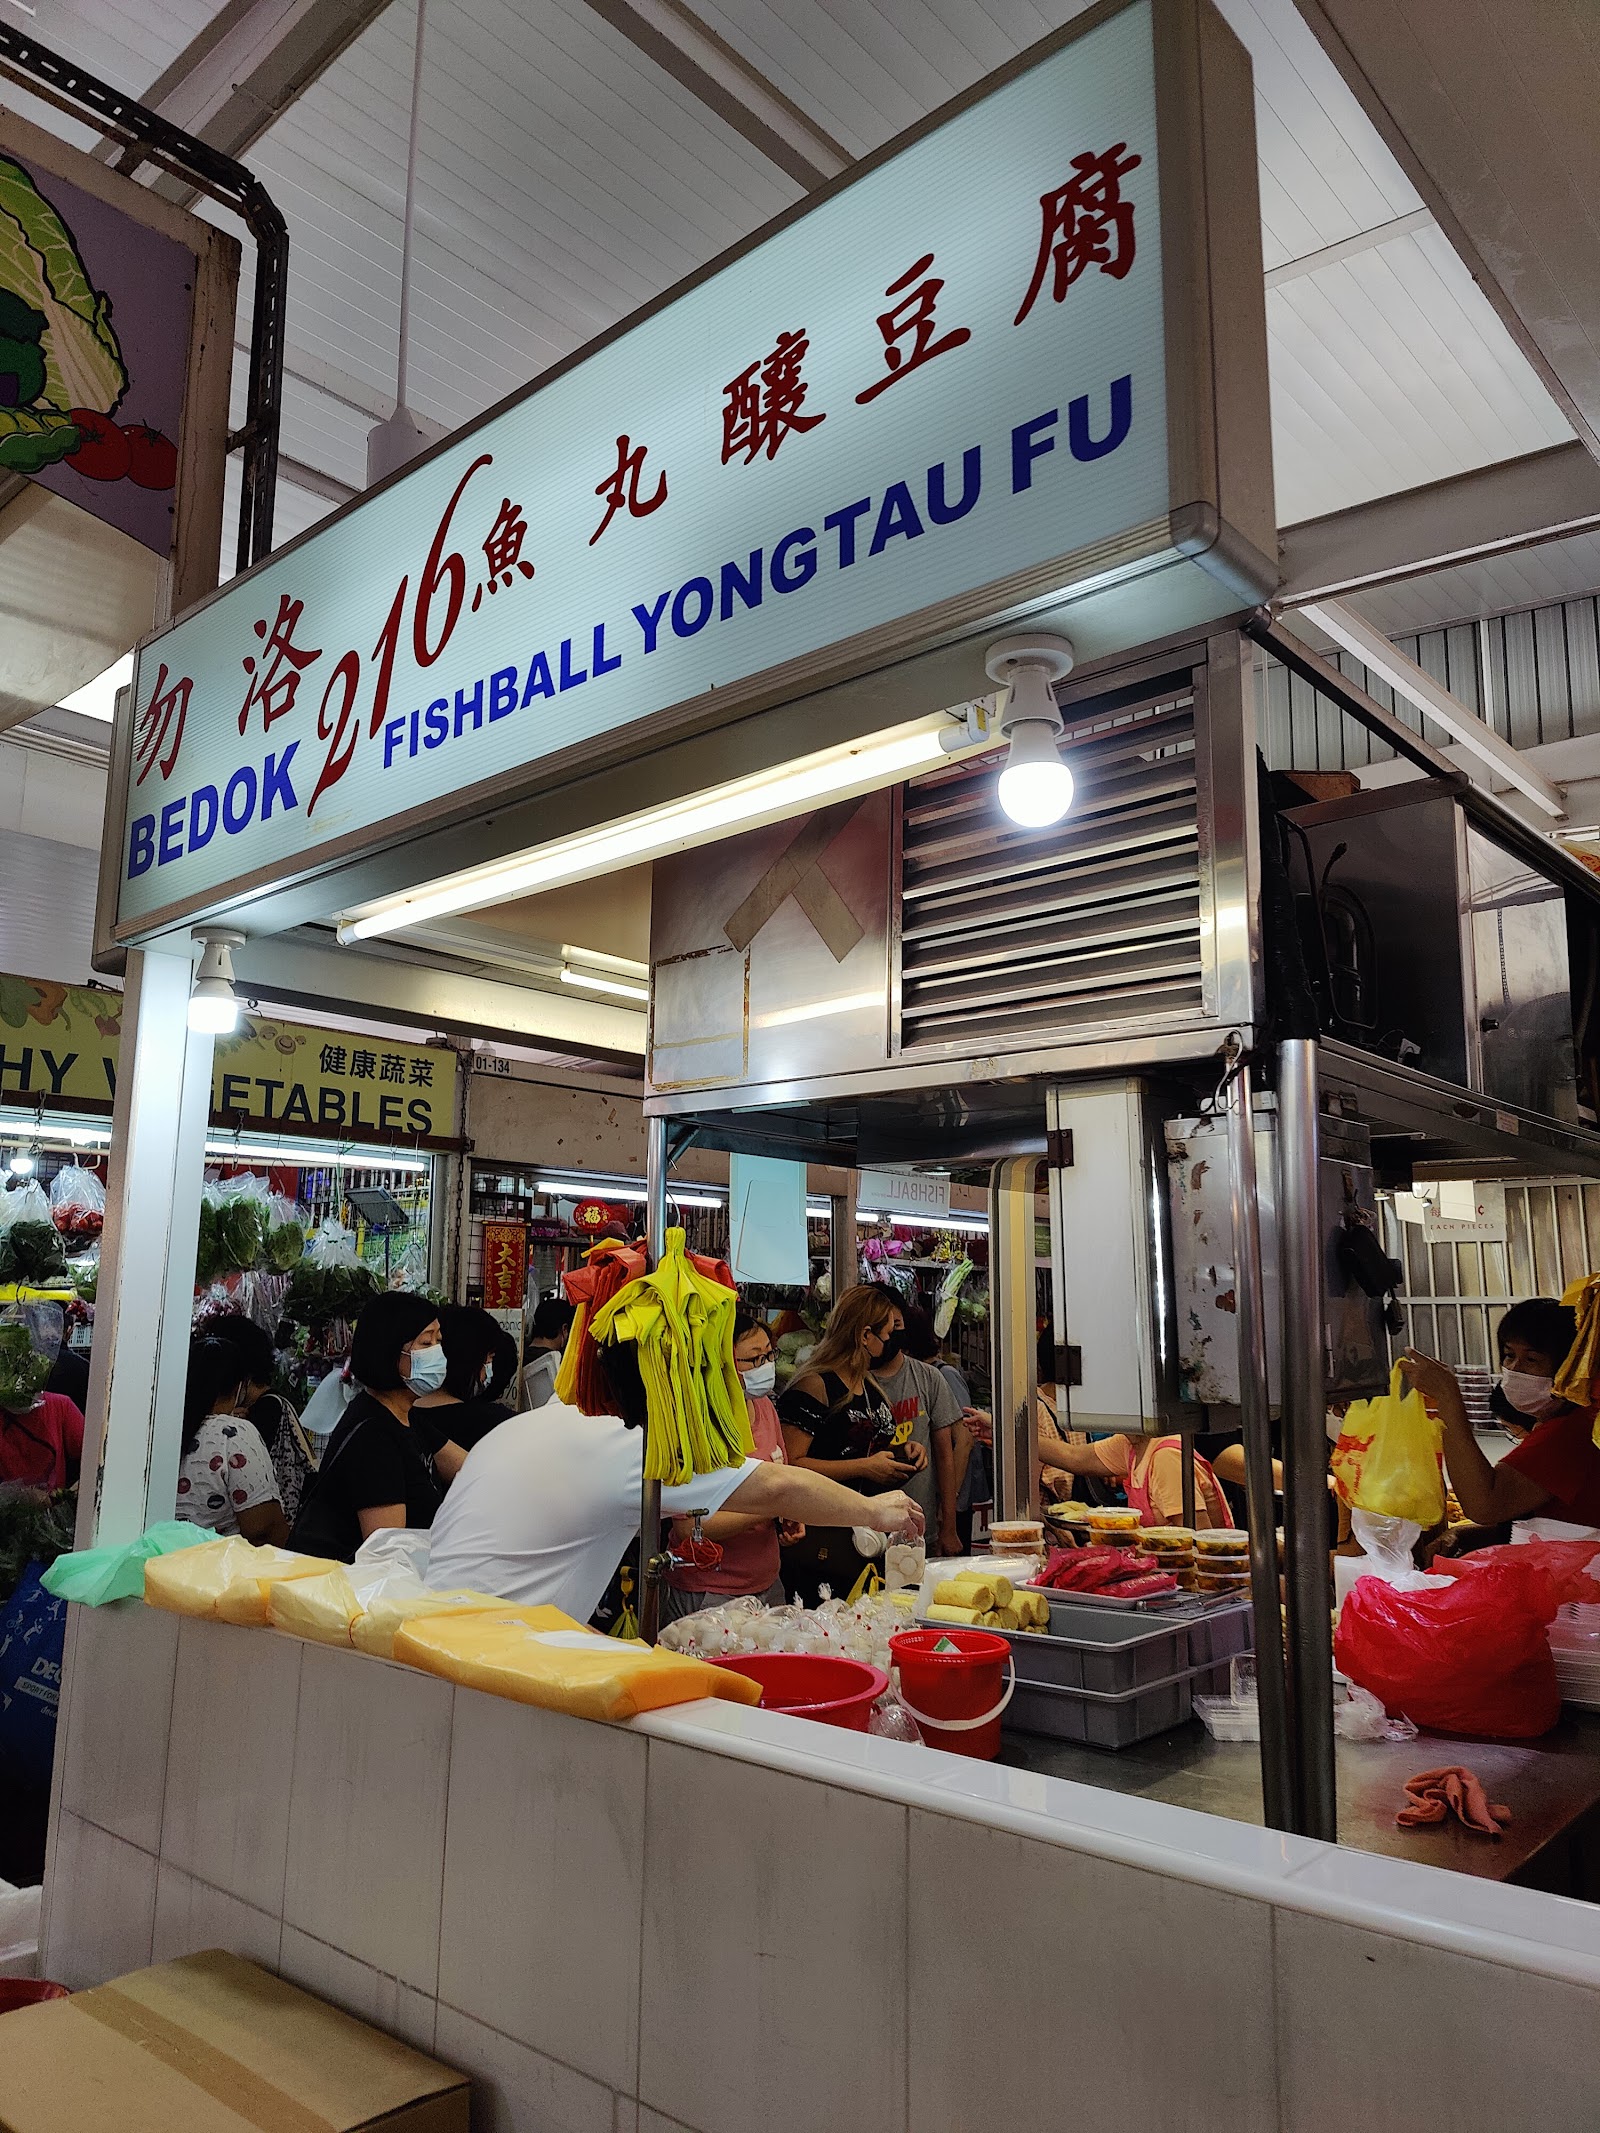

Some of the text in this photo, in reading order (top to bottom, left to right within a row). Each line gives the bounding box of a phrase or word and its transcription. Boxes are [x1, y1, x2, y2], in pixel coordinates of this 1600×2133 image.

[127, 373, 1132, 880] BEDOK FISHBALL YONGTAU FU
[136, 592, 323, 787] 勿洛
[306, 453, 493, 819] 216
[318, 1043, 435, 1088] 健康蔬菜
[475, 1056, 511, 1074] 01-134
[583, 1206, 602, 1225] 福
